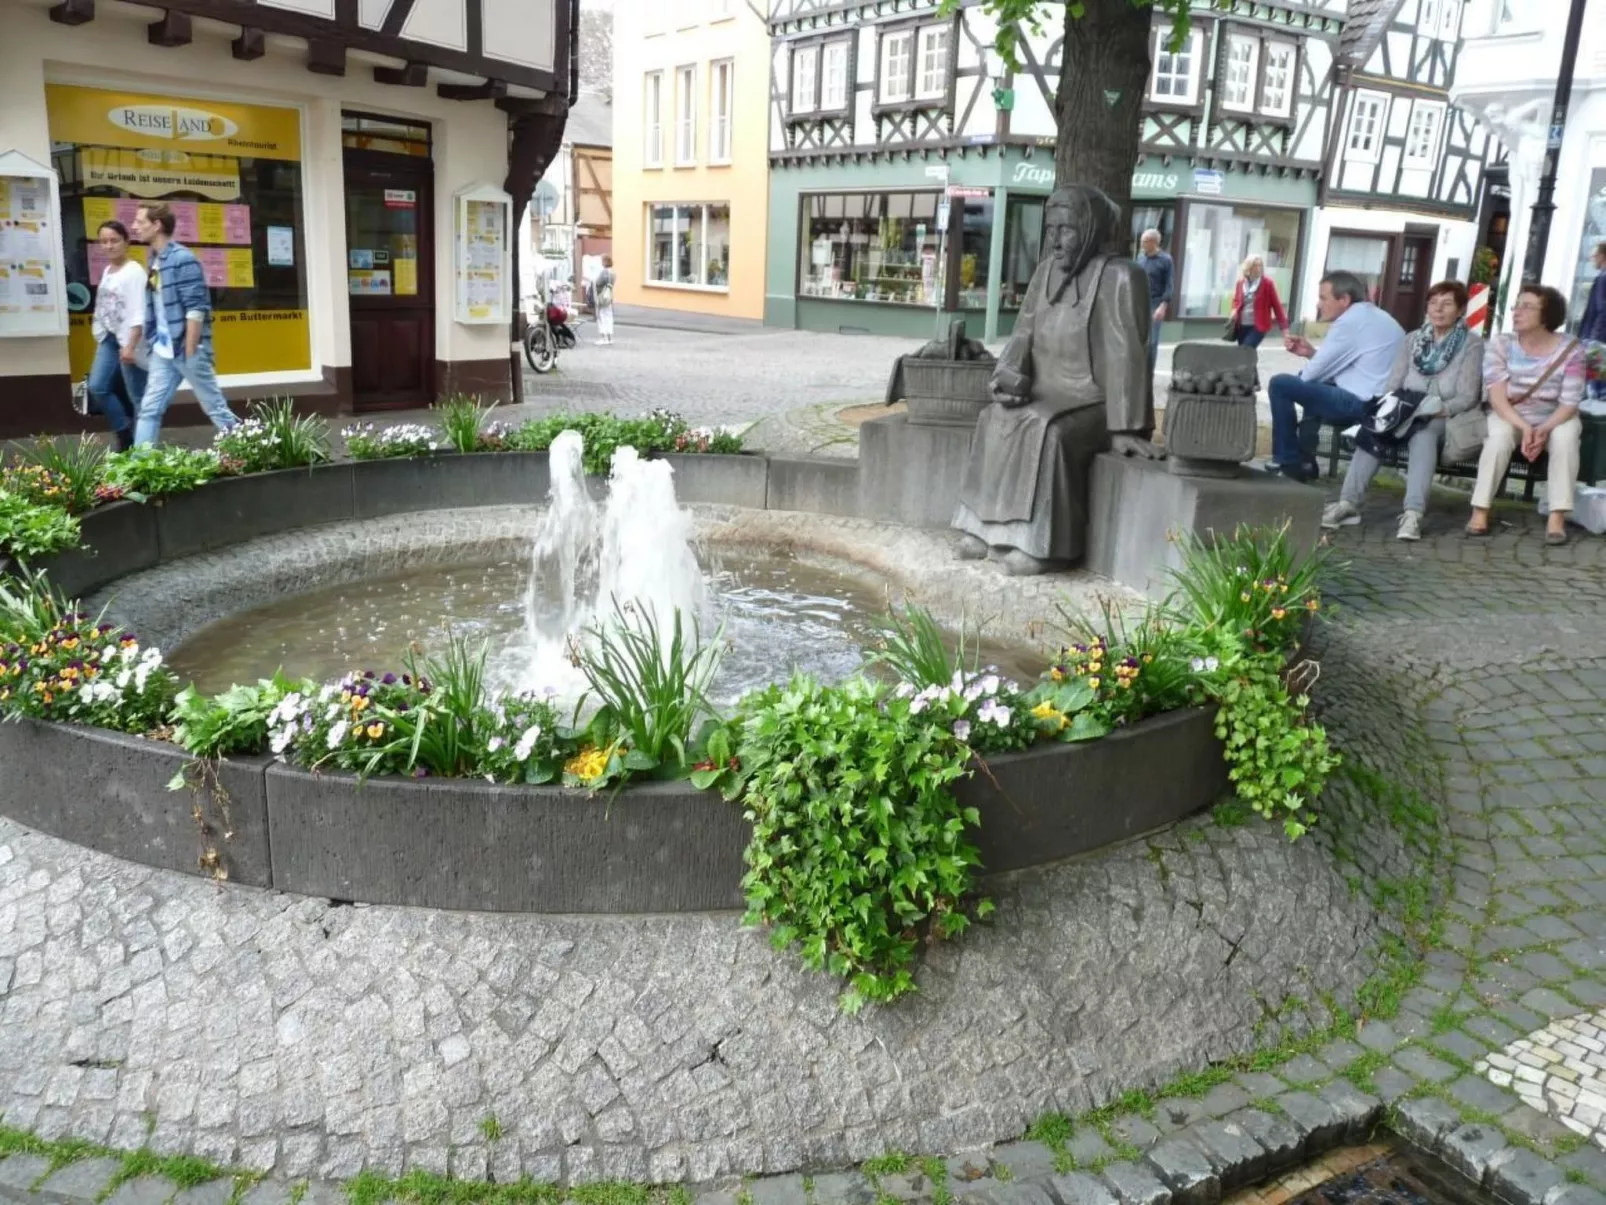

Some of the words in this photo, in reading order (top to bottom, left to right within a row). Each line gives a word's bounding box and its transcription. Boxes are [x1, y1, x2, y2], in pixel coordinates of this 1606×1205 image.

[1132, 173, 1177, 190] ams
[220, 314, 237, 323] am
[240, 311, 303, 322] Buttermarkt
